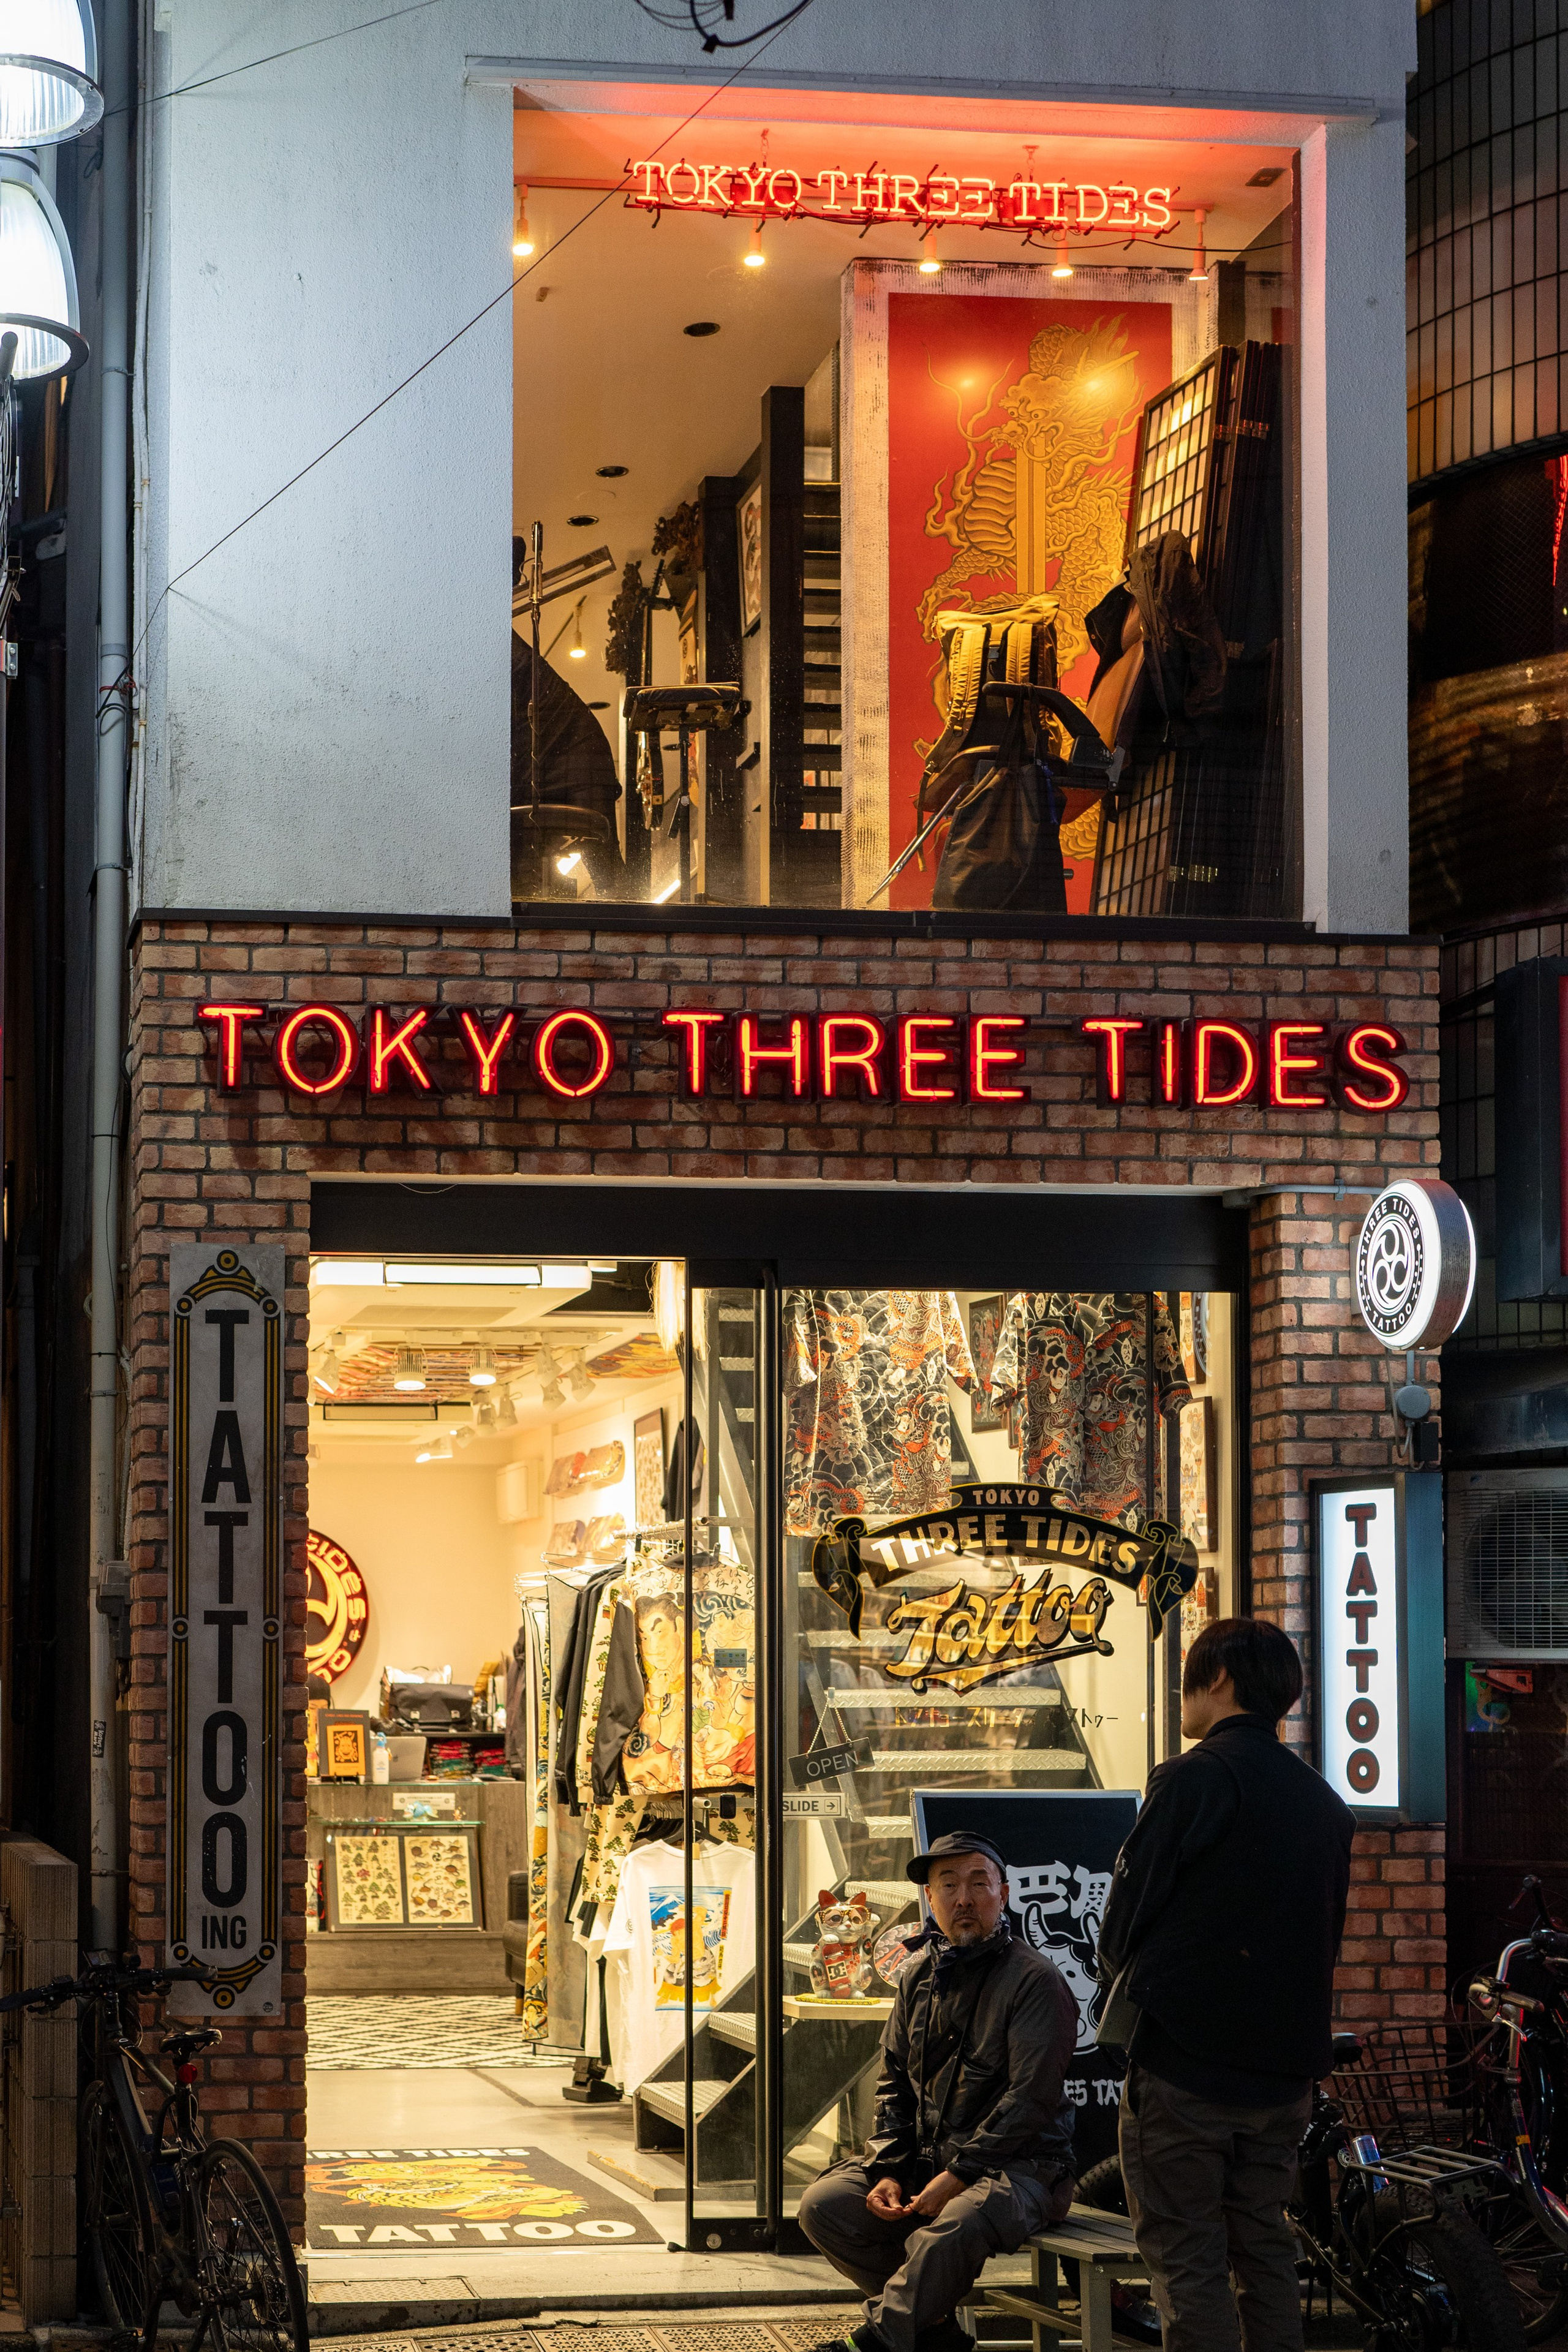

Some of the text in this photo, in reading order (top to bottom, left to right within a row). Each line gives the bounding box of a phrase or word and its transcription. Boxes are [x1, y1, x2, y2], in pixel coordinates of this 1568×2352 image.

[633, 160, 1171, 227] TOKYO THREE TIDES
[195, 1002, 1410, 1115] TOKYO THREE TIDES
[1361, 1198, 1420, 1256] THREE TIDES
[1372, 1303, 1412, 1331] TATTOO
[972, 1489, 1040, 1507] TOKYO
[871, 1516, 1140, 1574] THREE TIDES
[201, 1309, 252, 1908] TATTOO
[884, 1568, 1115, 1688] Tattoo
[1345, 1502, 1380, 1794] TATTOO
[807, 1751, 859, 1776] OPEN
[783, 1801, 819, 1812] SLIDE
[202, 1915, 246, 1949] ING
[403, 2149, 530, 2158] TIDES
[320, 2220, 636, 2243] TATTOO
